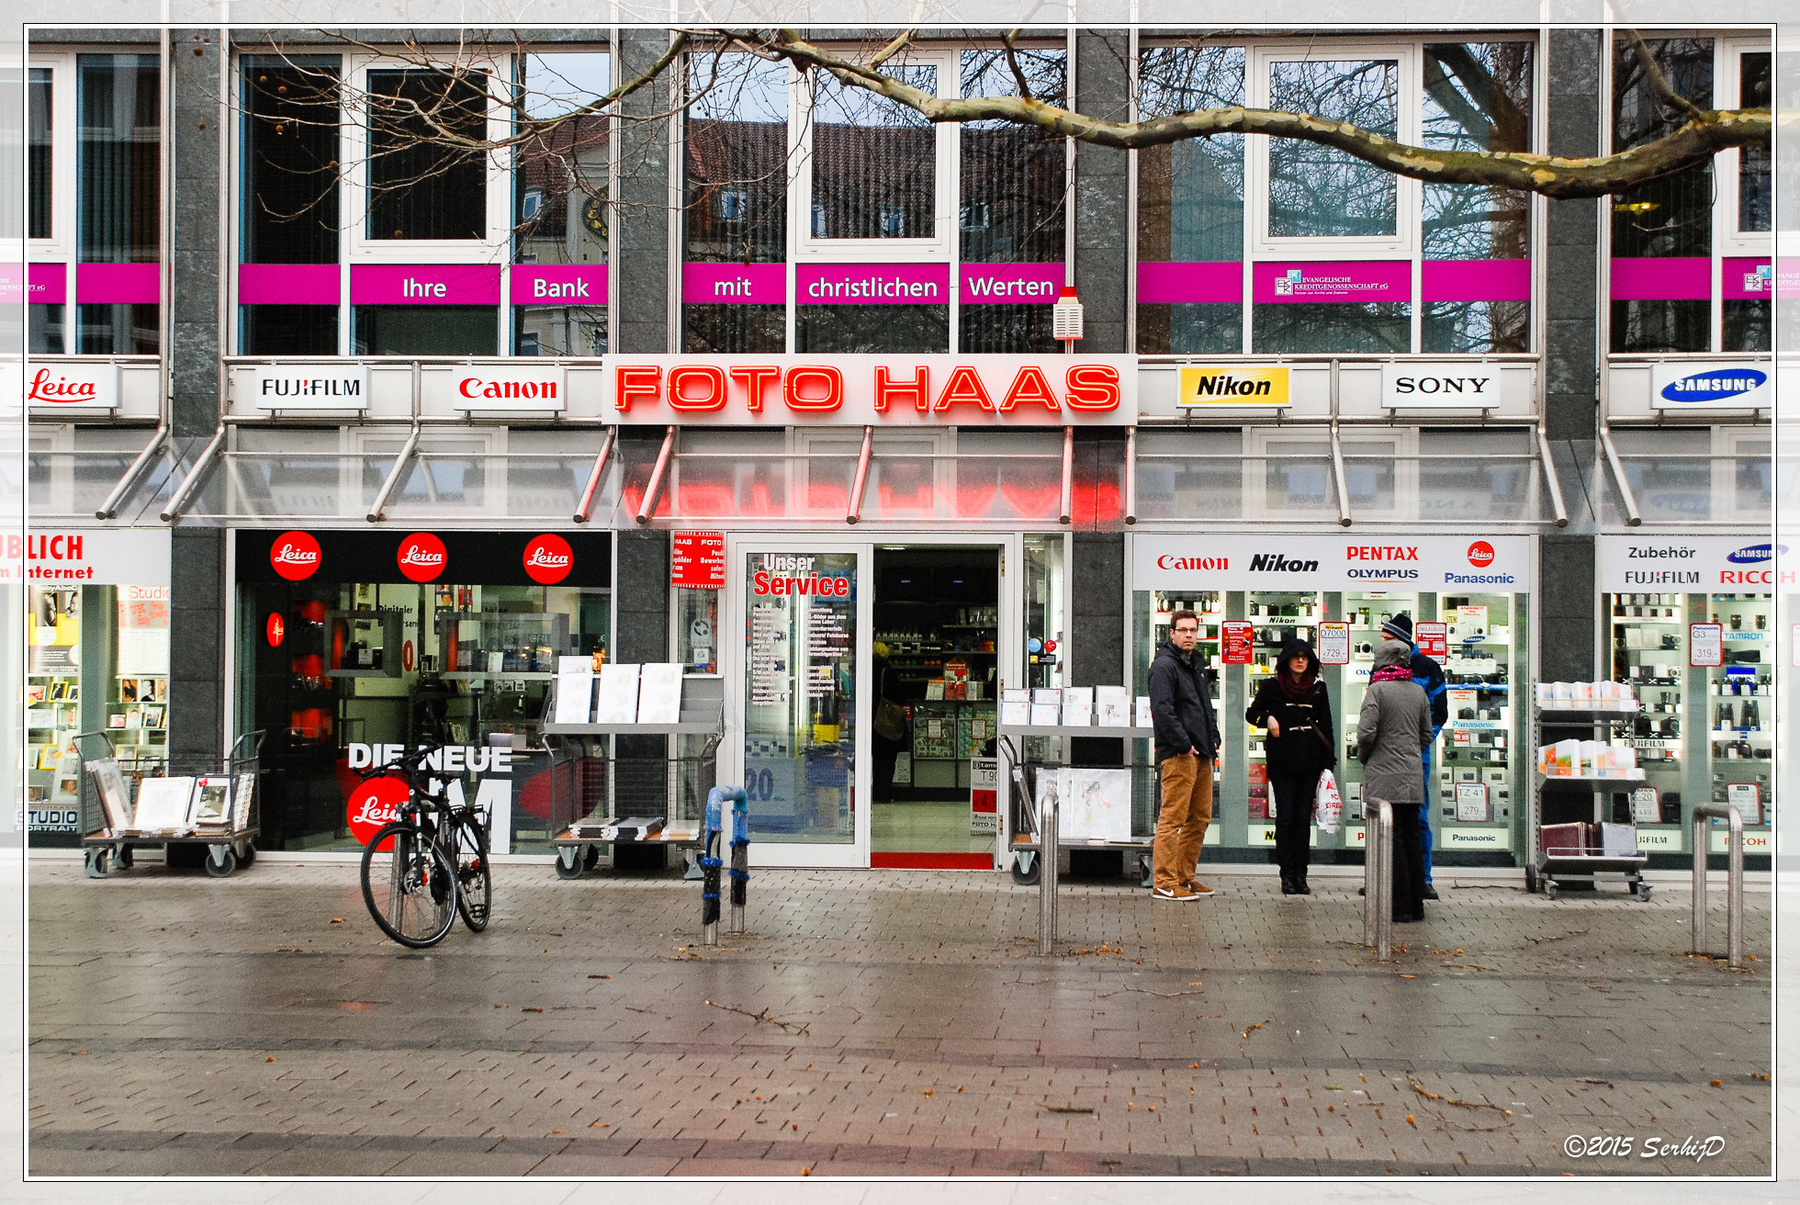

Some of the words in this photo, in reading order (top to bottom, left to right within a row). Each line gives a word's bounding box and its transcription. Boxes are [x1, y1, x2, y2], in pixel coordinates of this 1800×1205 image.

[403, 278, 447, 297] Ihre
[534, 278, 590, 297] Bank
[714, 278, 752, 297] mit
[809, 277, 938, 298] christlichen
[969, 277, 1054, 297] Werten
[24, 368, 96, 403] Leica
[263, 379, 360, 396] FUJIFILM
[459, 378, 557, 399] Canon
[614, 365, 845, 412] FOTO
[874, 365, 1120, 413] HAAS
[1197, 375, 1271, 395] Nikon
[1396, 377, 1490, 393] SONY
[1674, 378, 1757, 391] SAMSUNG
[275, 544, 316, 565] Leica
[401, 545, 442, 566] Leica
[527, 546, 568, 568] Leica
[1347, 546, 1418, 561] PENTAX
[1468, 545, 1493, 560] Leica
[1628, 546, 1696, 559] Zubehör
[763, 554, 815, 571] Unser
[1157, 554, 1229, 570] Canon
[1249, 554, 1319, 572] Nikon
[1347, 569, 1419, 579] OLYMPUS
[1445, 572, 1514, 584] Panasonic
[1625, 571, 1699, 584] FUJIFILM
[754, 571, 848, 596] Service
[1723, 632, 1764, 640] TAMRON
[1453, 720, 1495, 728] Panasonic
[348, 743, 404, 769] DIE
[418, 745, 512, 772] NEUE
[429, 777, 512, 854] M
